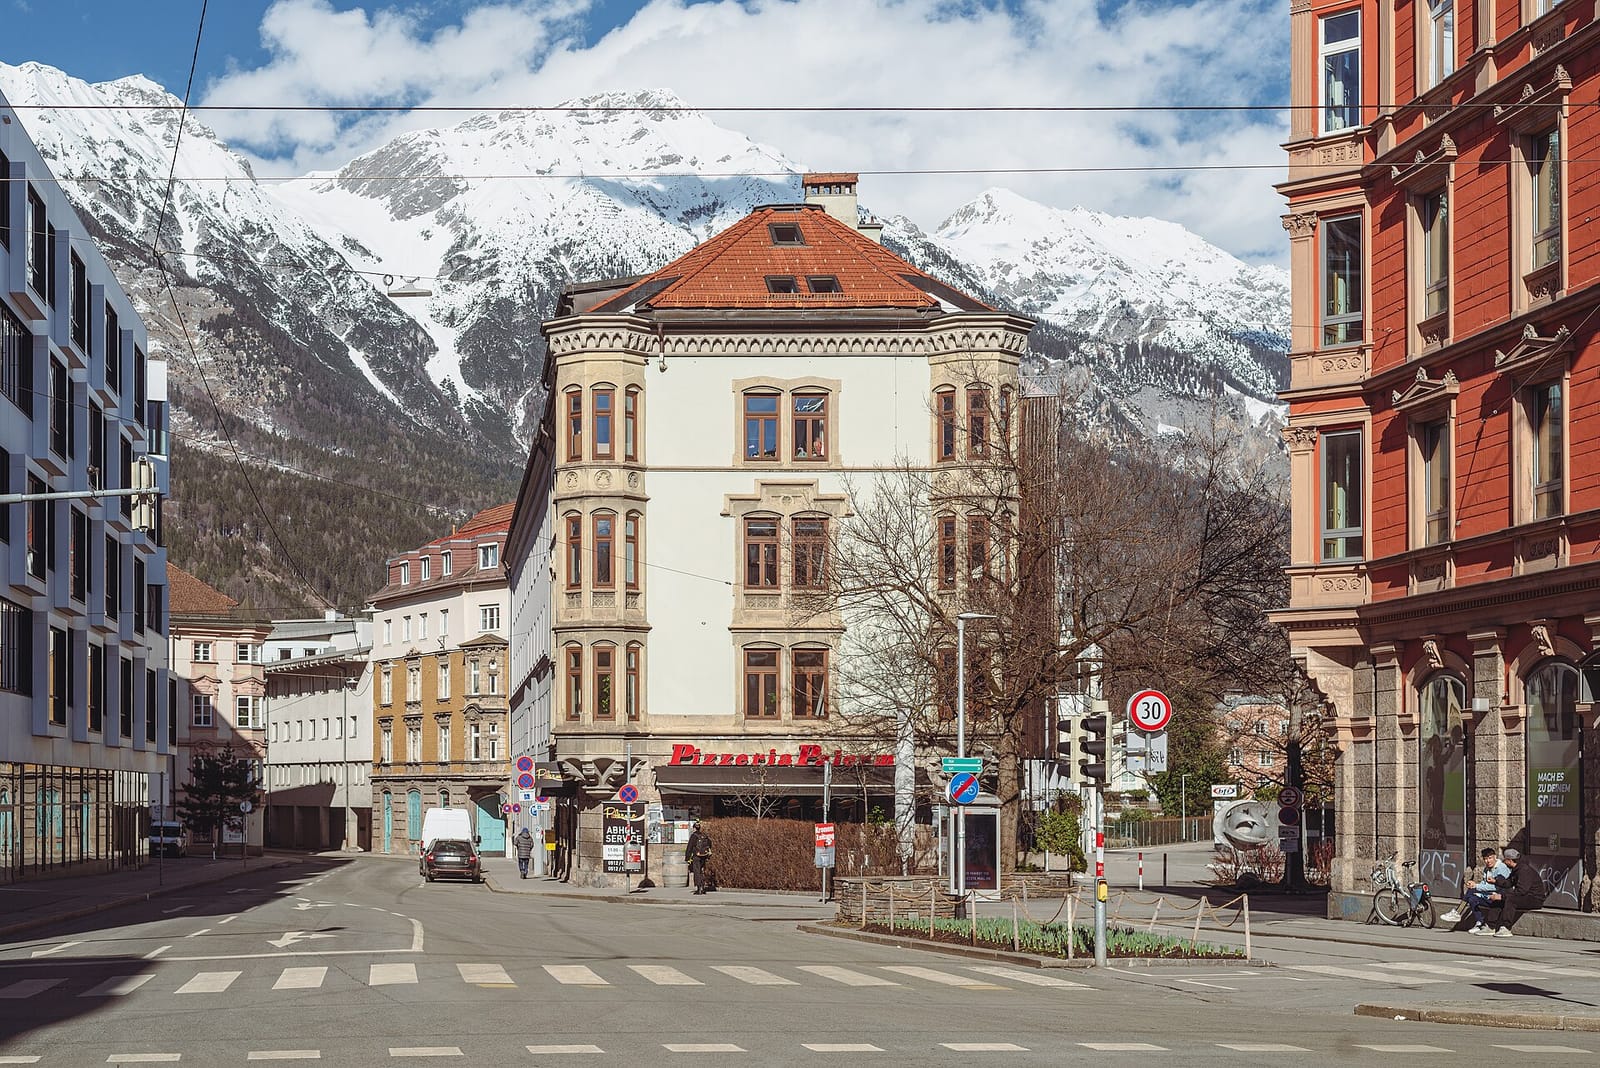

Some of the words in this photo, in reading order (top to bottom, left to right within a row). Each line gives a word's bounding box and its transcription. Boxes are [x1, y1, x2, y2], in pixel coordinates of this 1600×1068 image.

[1141, 702, 1161, 720] 30
[667, 743, 793, 767] Pizzeria
[795, 744, 895, 767] Palerm
[1537, 772, 1556, 782] MACH
[1556, 772, 1565, 782] ES
[1537, 783, 1547, 793] ZU
[1547, 783, 1571, 793] DEINEM
[1537, 794, 1565, 808] SPIEL!
[605, 834, 642, 843] SERVCE
